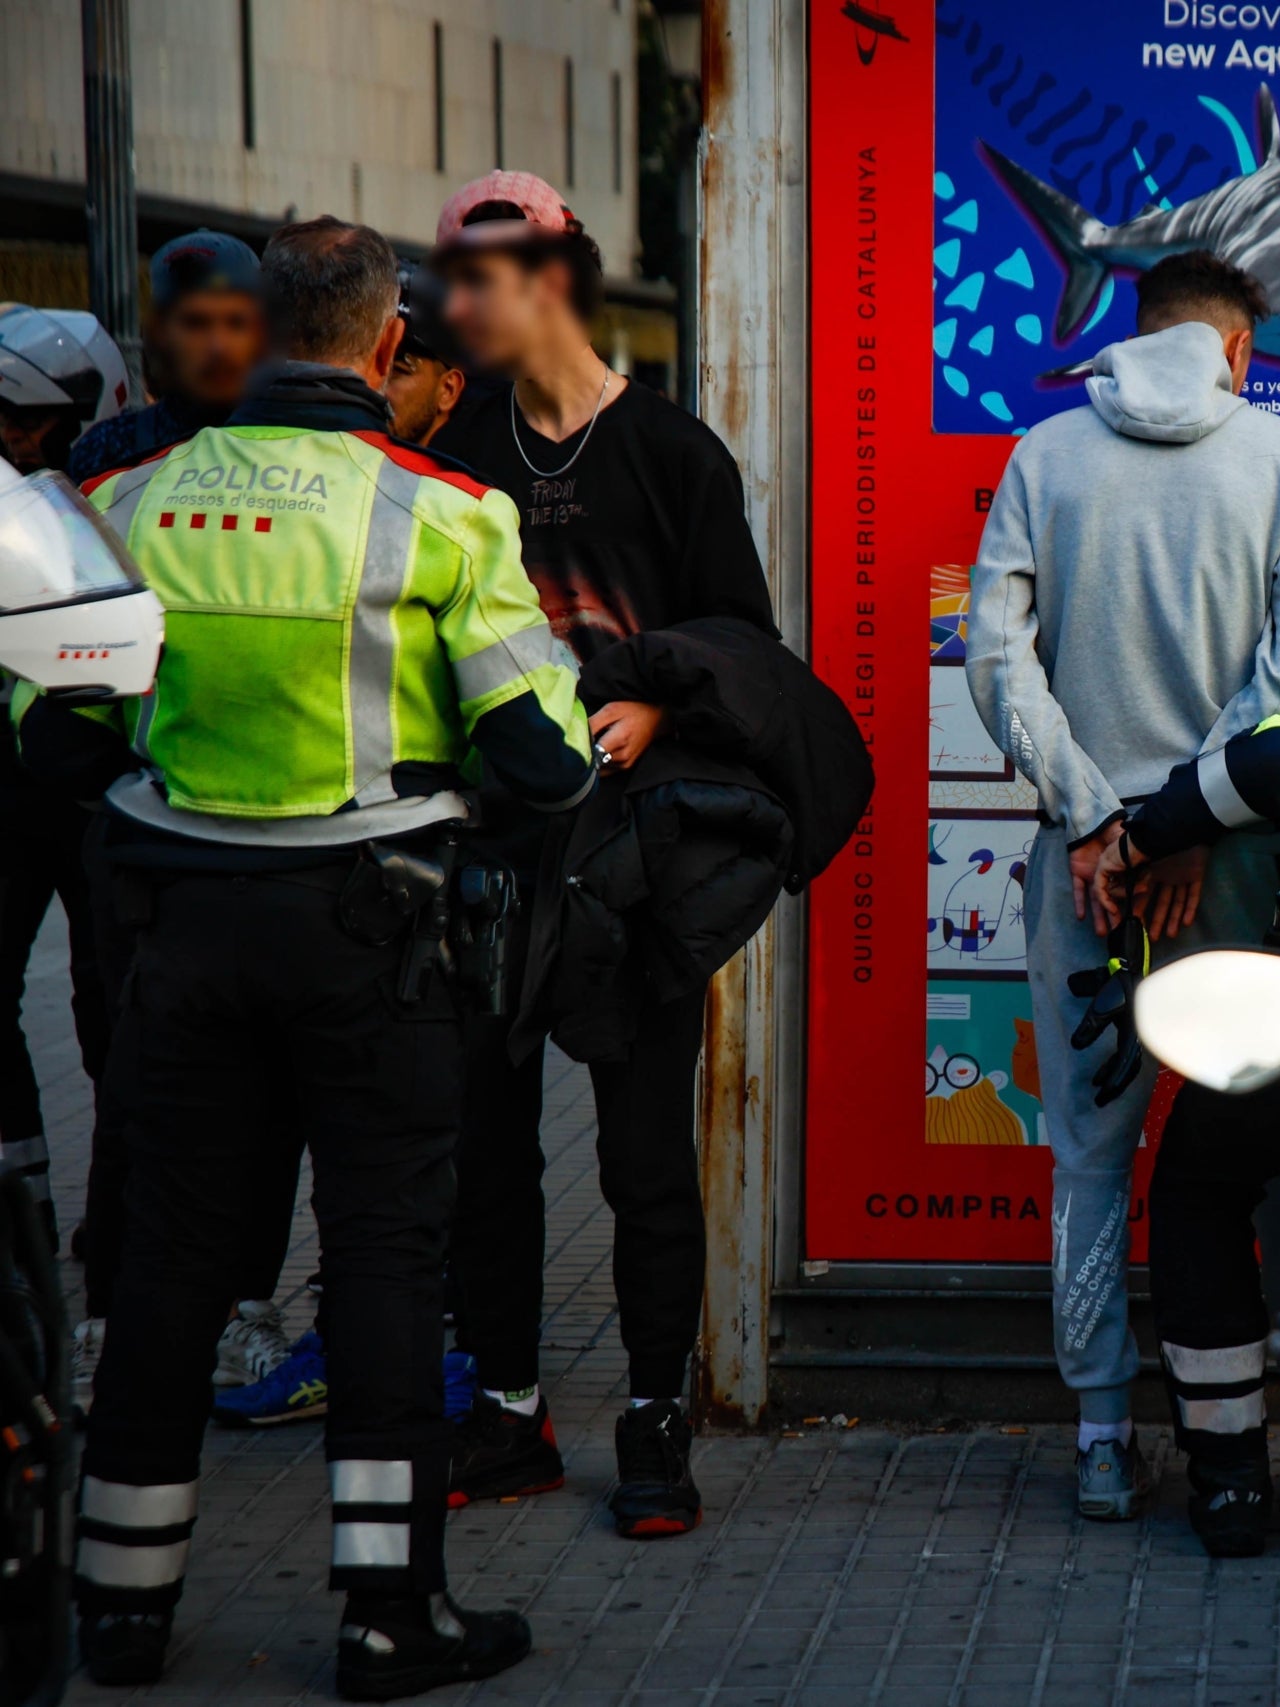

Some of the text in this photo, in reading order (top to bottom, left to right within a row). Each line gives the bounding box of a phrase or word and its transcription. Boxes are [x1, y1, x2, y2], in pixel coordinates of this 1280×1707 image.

[1143, 42, 1216, 68] new
[857, 146, 877, 320] CATALUNYA
[857, 335, 876, 371] DE
[1253, 381, 1264, 392] a
[173, 464, 328, 499] POLICIA
[531, 478, 577, 505] FRIDAY
[856, 387, 876, 585] PERIODISTES
[164, 493, 327, 514] mossos d'esquadra
[857, 601, 875, 637] DE
[854, 872, 873, 983] QUIOSC
[866, 1193, 1041, 1220] COMPRA
[1060, 1190, 1124, 1319] NIKE SPORTSWEAR
[1074, 1296, 1093, 1321] Inc.
[1087, 1265, 1108, 1292] One
[1074, 1281, 1115, 1350] Beaverton,
